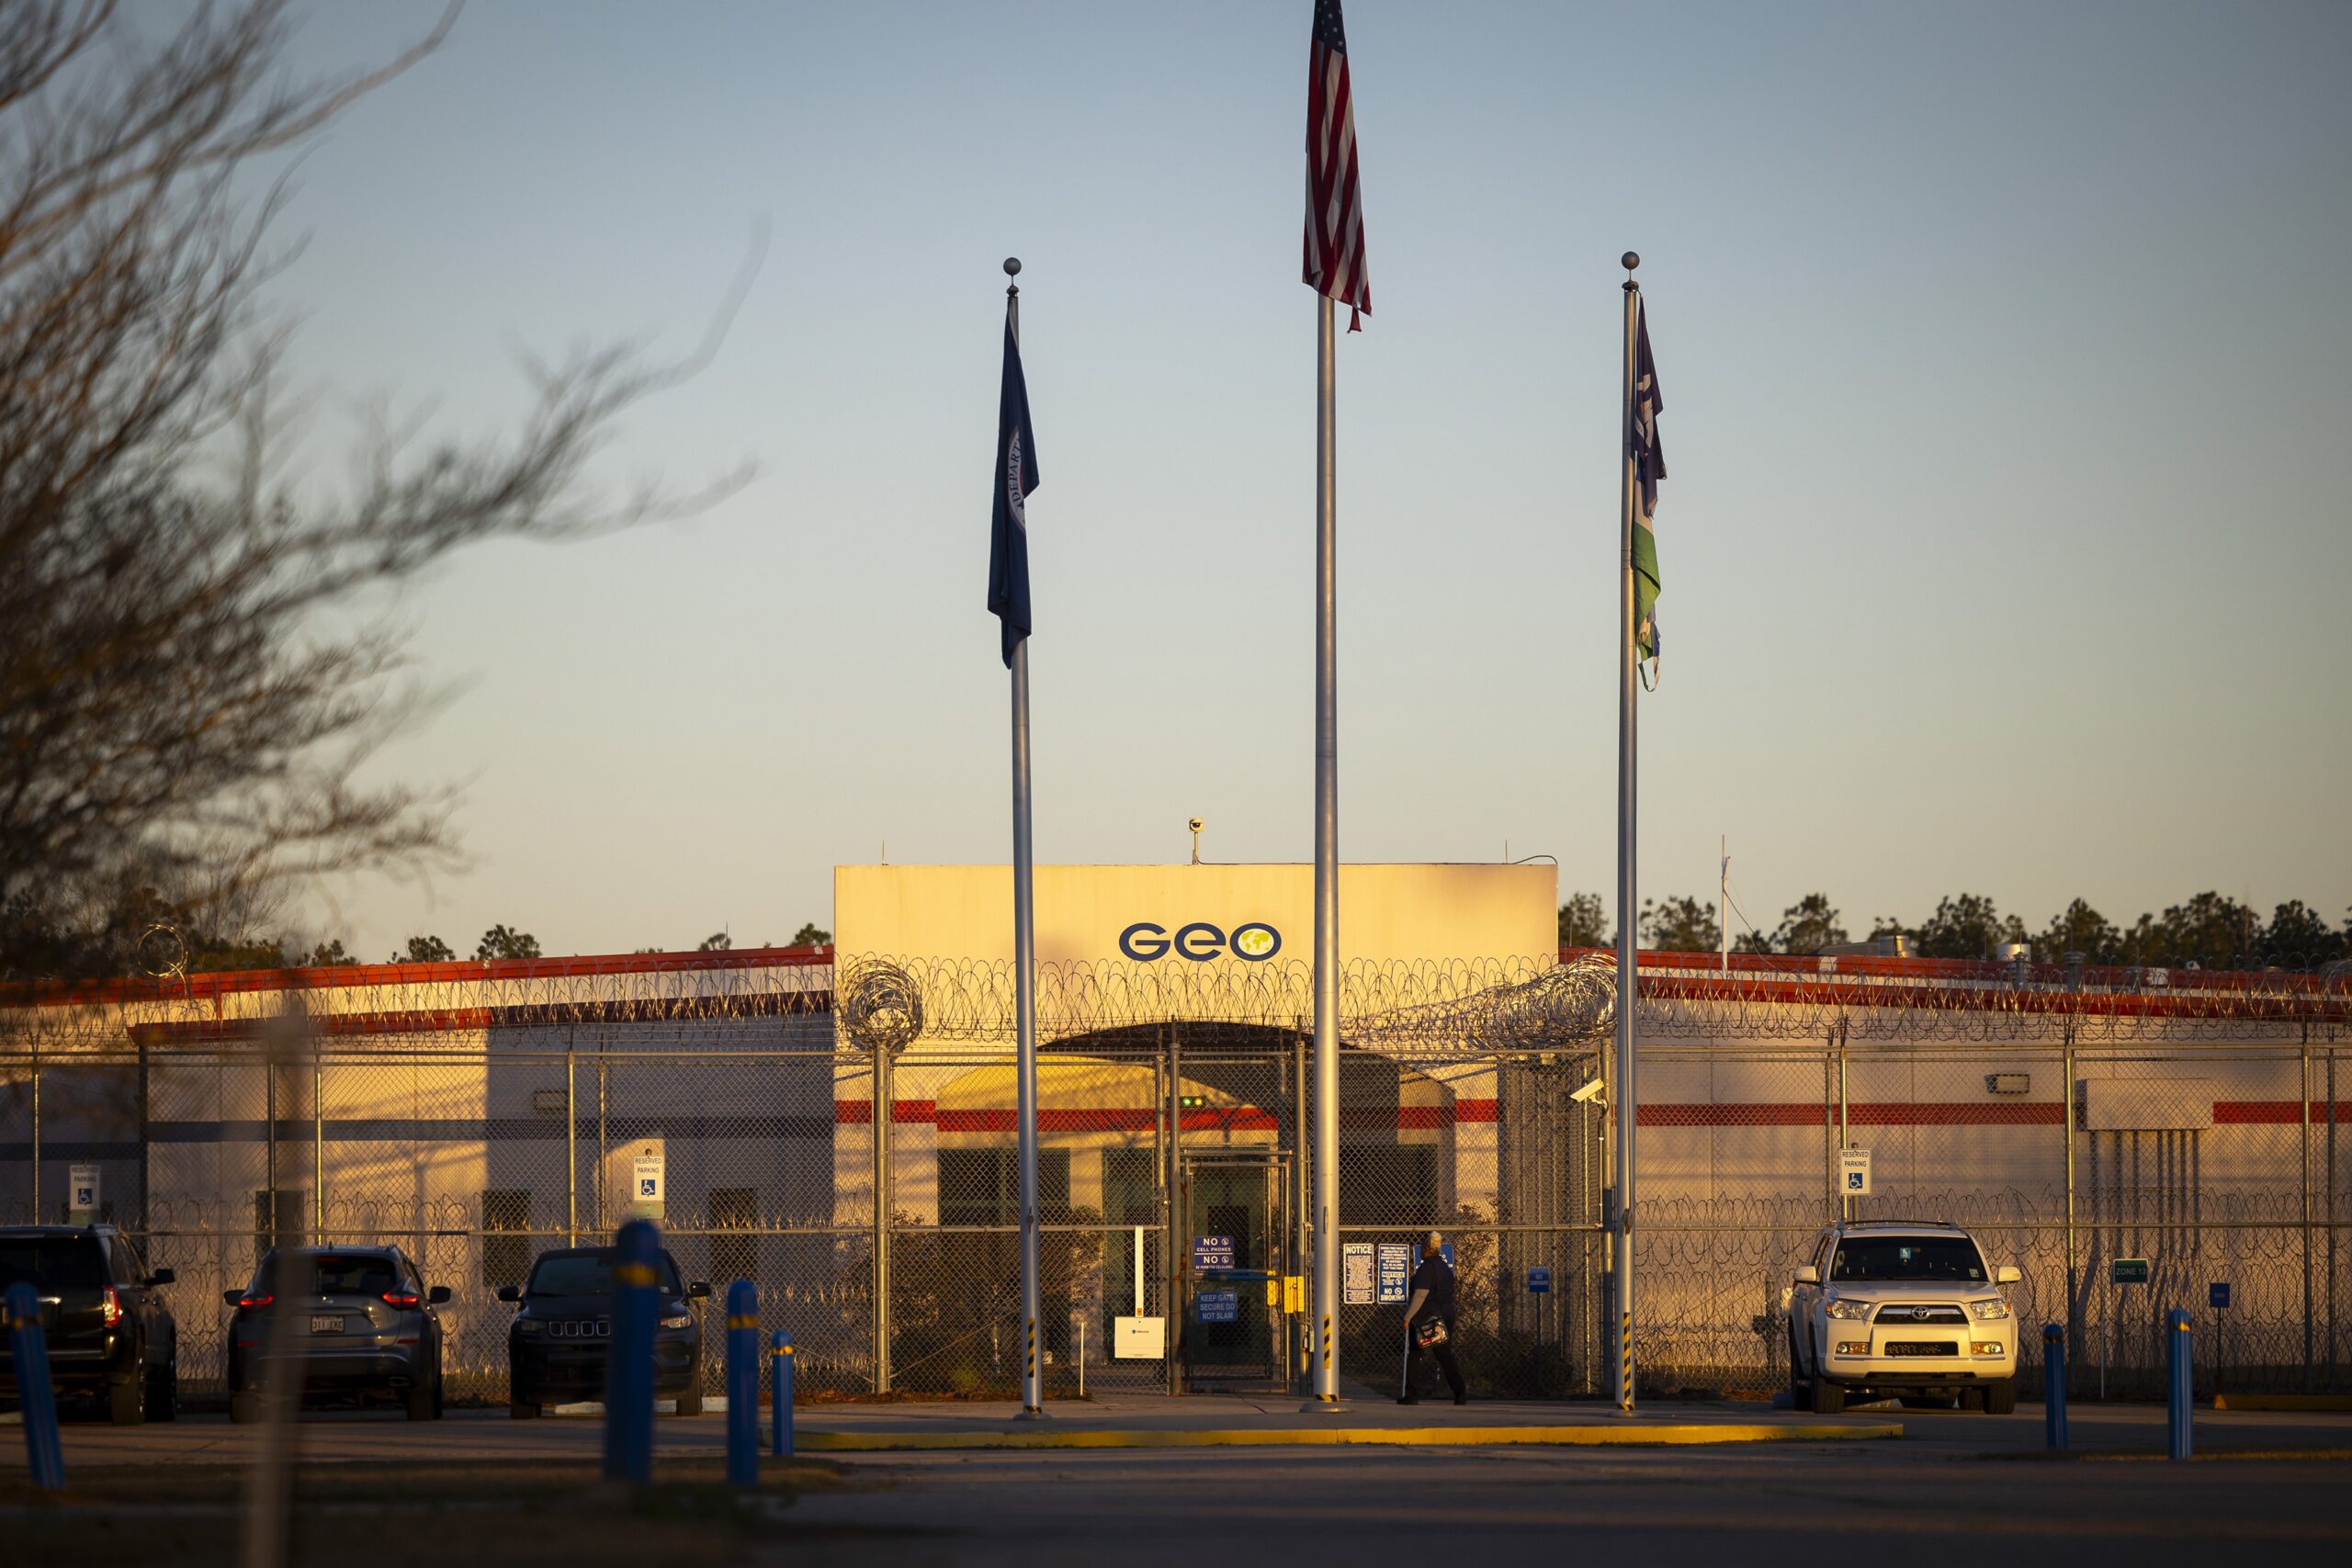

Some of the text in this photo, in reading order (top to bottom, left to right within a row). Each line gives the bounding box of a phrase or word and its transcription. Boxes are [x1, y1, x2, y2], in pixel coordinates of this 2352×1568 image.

[1203, 1237, 1218, 1246] NO
[1346, 1246, 1373, 1254] NOTICE
[1203, 1256, 1218, 1264] NO
[1218, 1293, 1234, 1302] GATE
